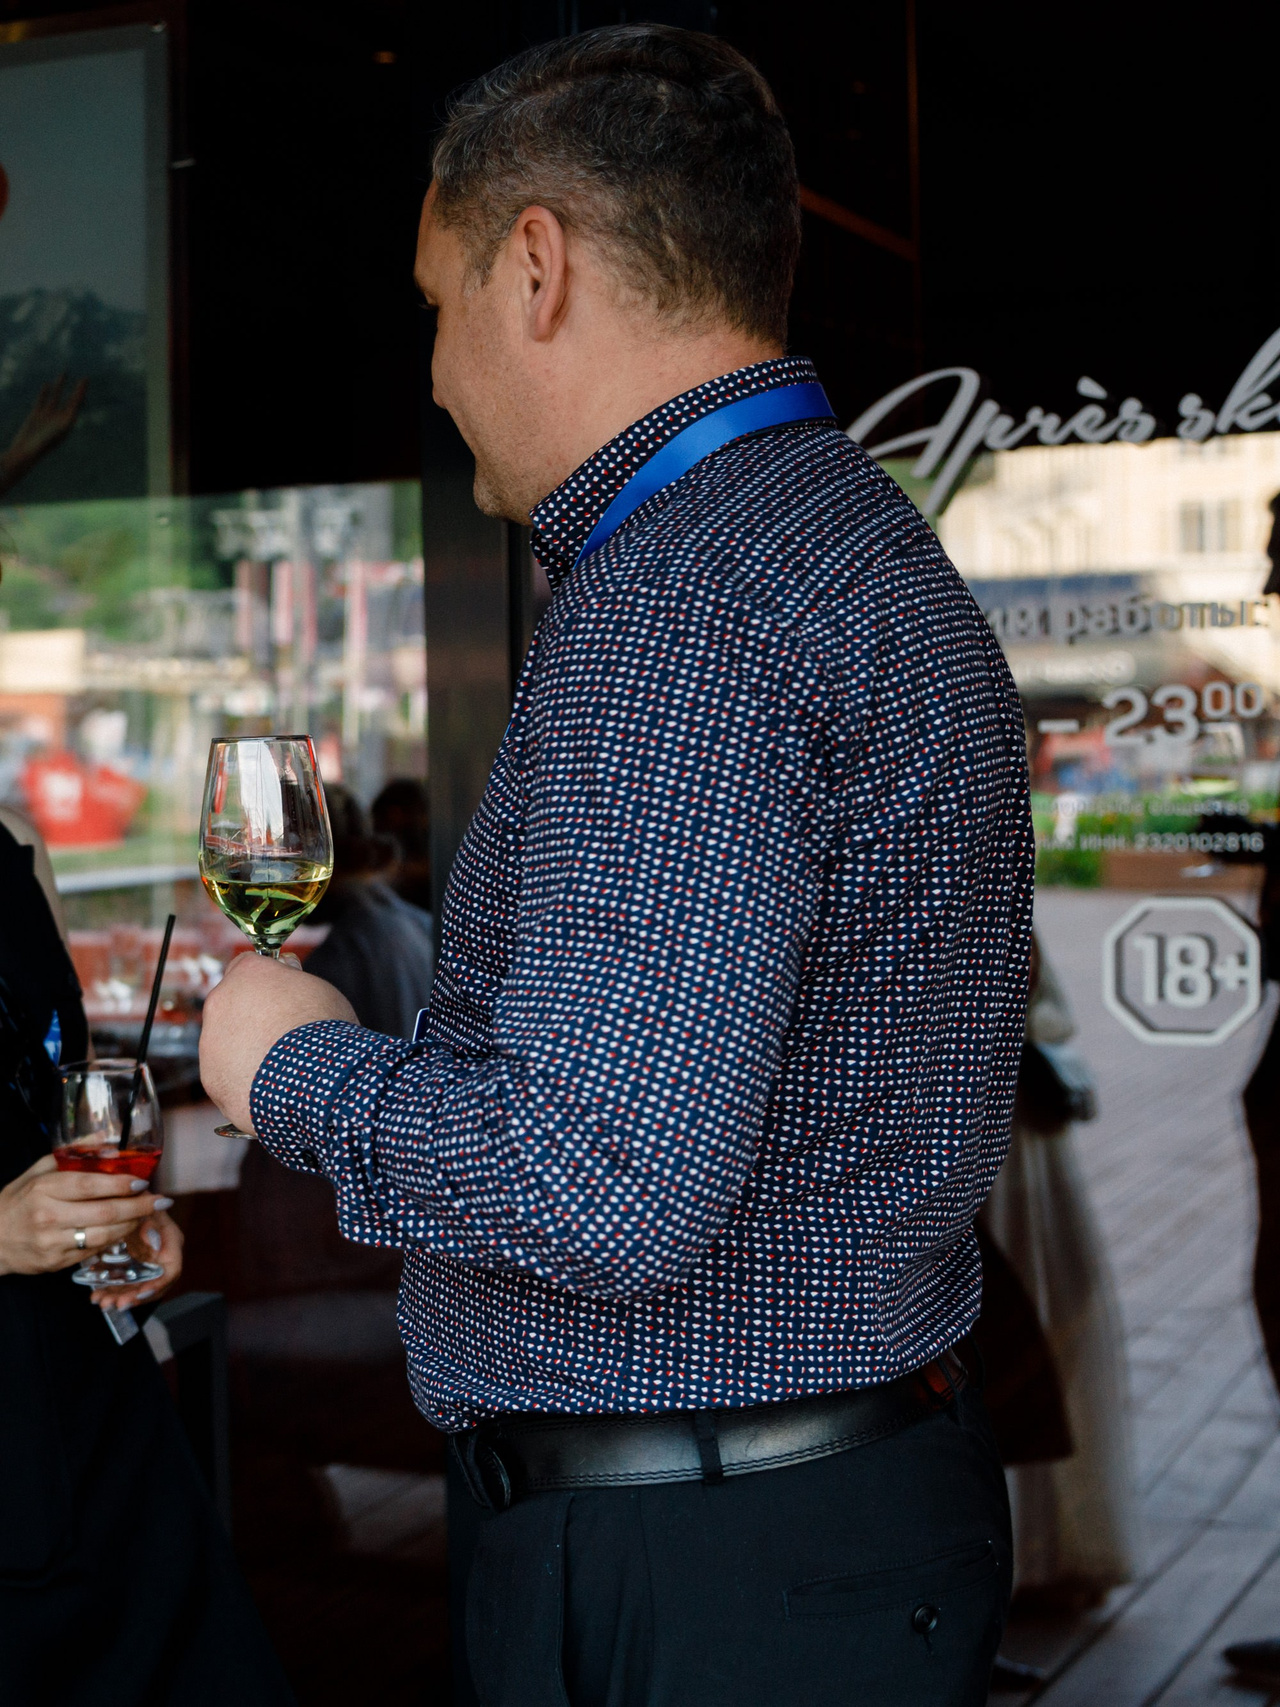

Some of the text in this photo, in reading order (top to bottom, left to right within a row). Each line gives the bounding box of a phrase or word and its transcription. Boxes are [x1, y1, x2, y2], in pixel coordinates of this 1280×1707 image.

[846, 326, 1280, 517] Après sk
[1133, 935, 1252, 1009] 18+
